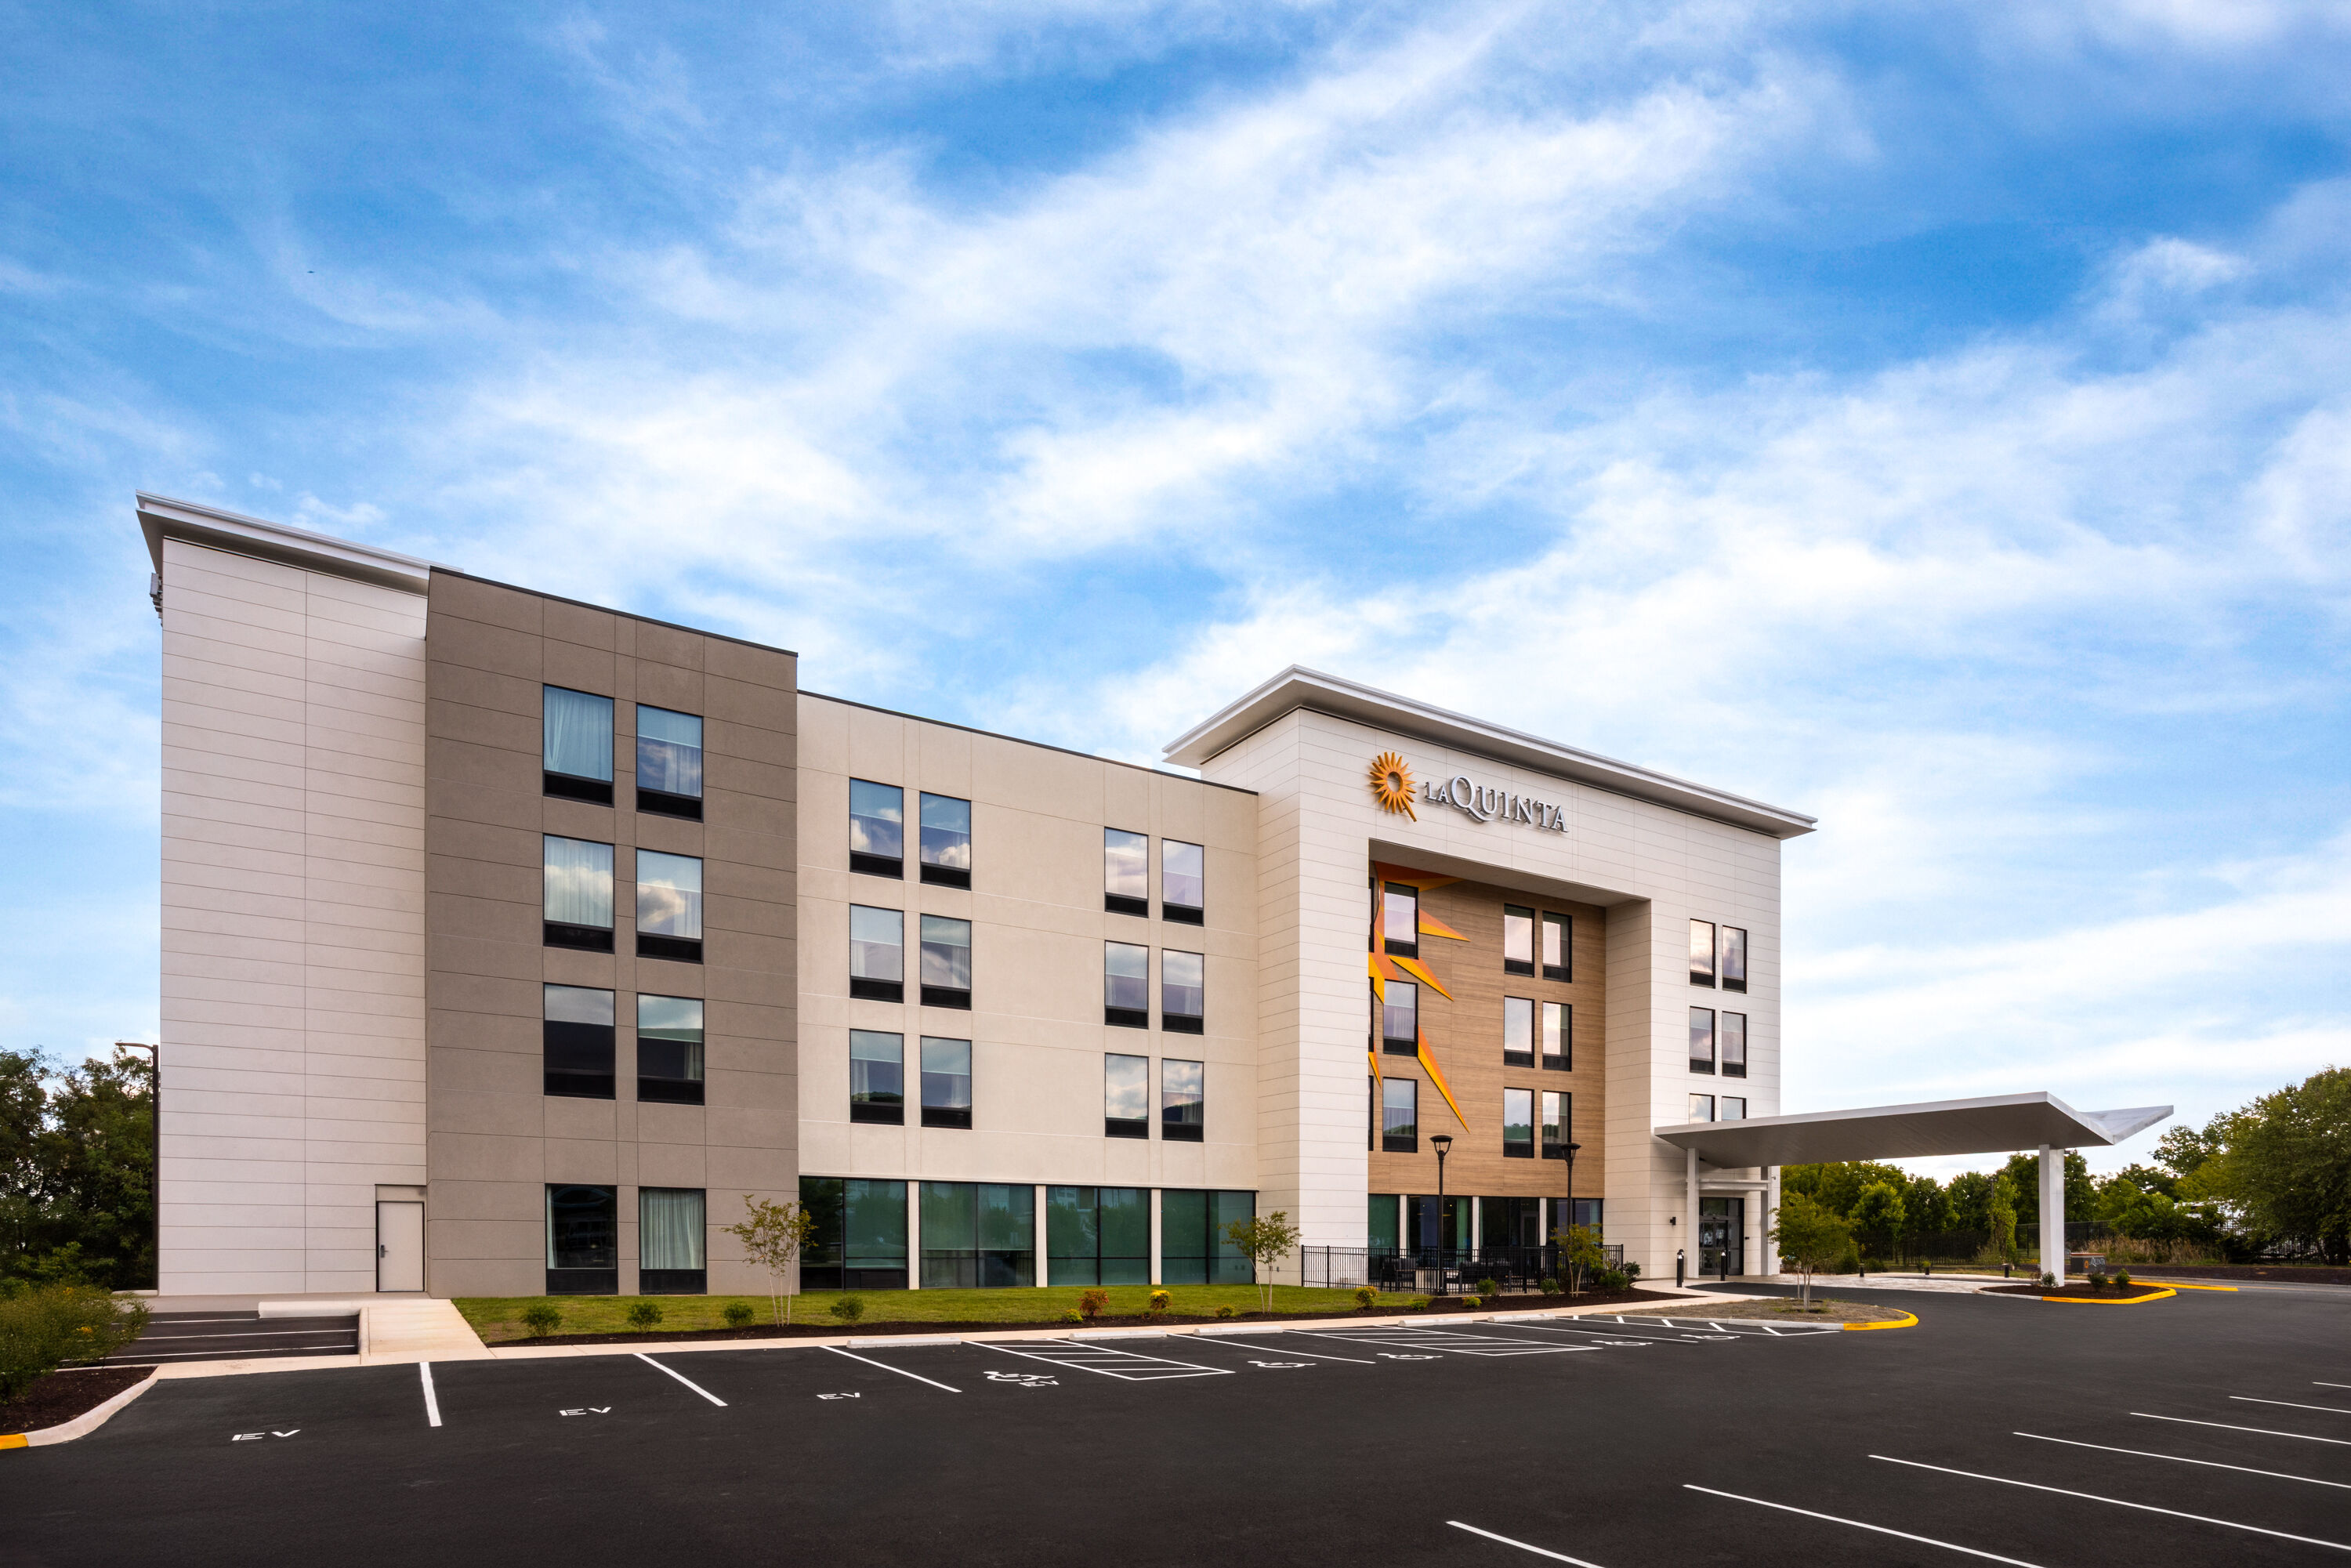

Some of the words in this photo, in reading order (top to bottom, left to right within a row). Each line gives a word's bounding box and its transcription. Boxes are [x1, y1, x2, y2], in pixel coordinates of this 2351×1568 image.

[1451, 775, 1568, 832] QUINTA
[559, 1407, 611, 1416] EV
[231, 1429, 301, 1441] EV
